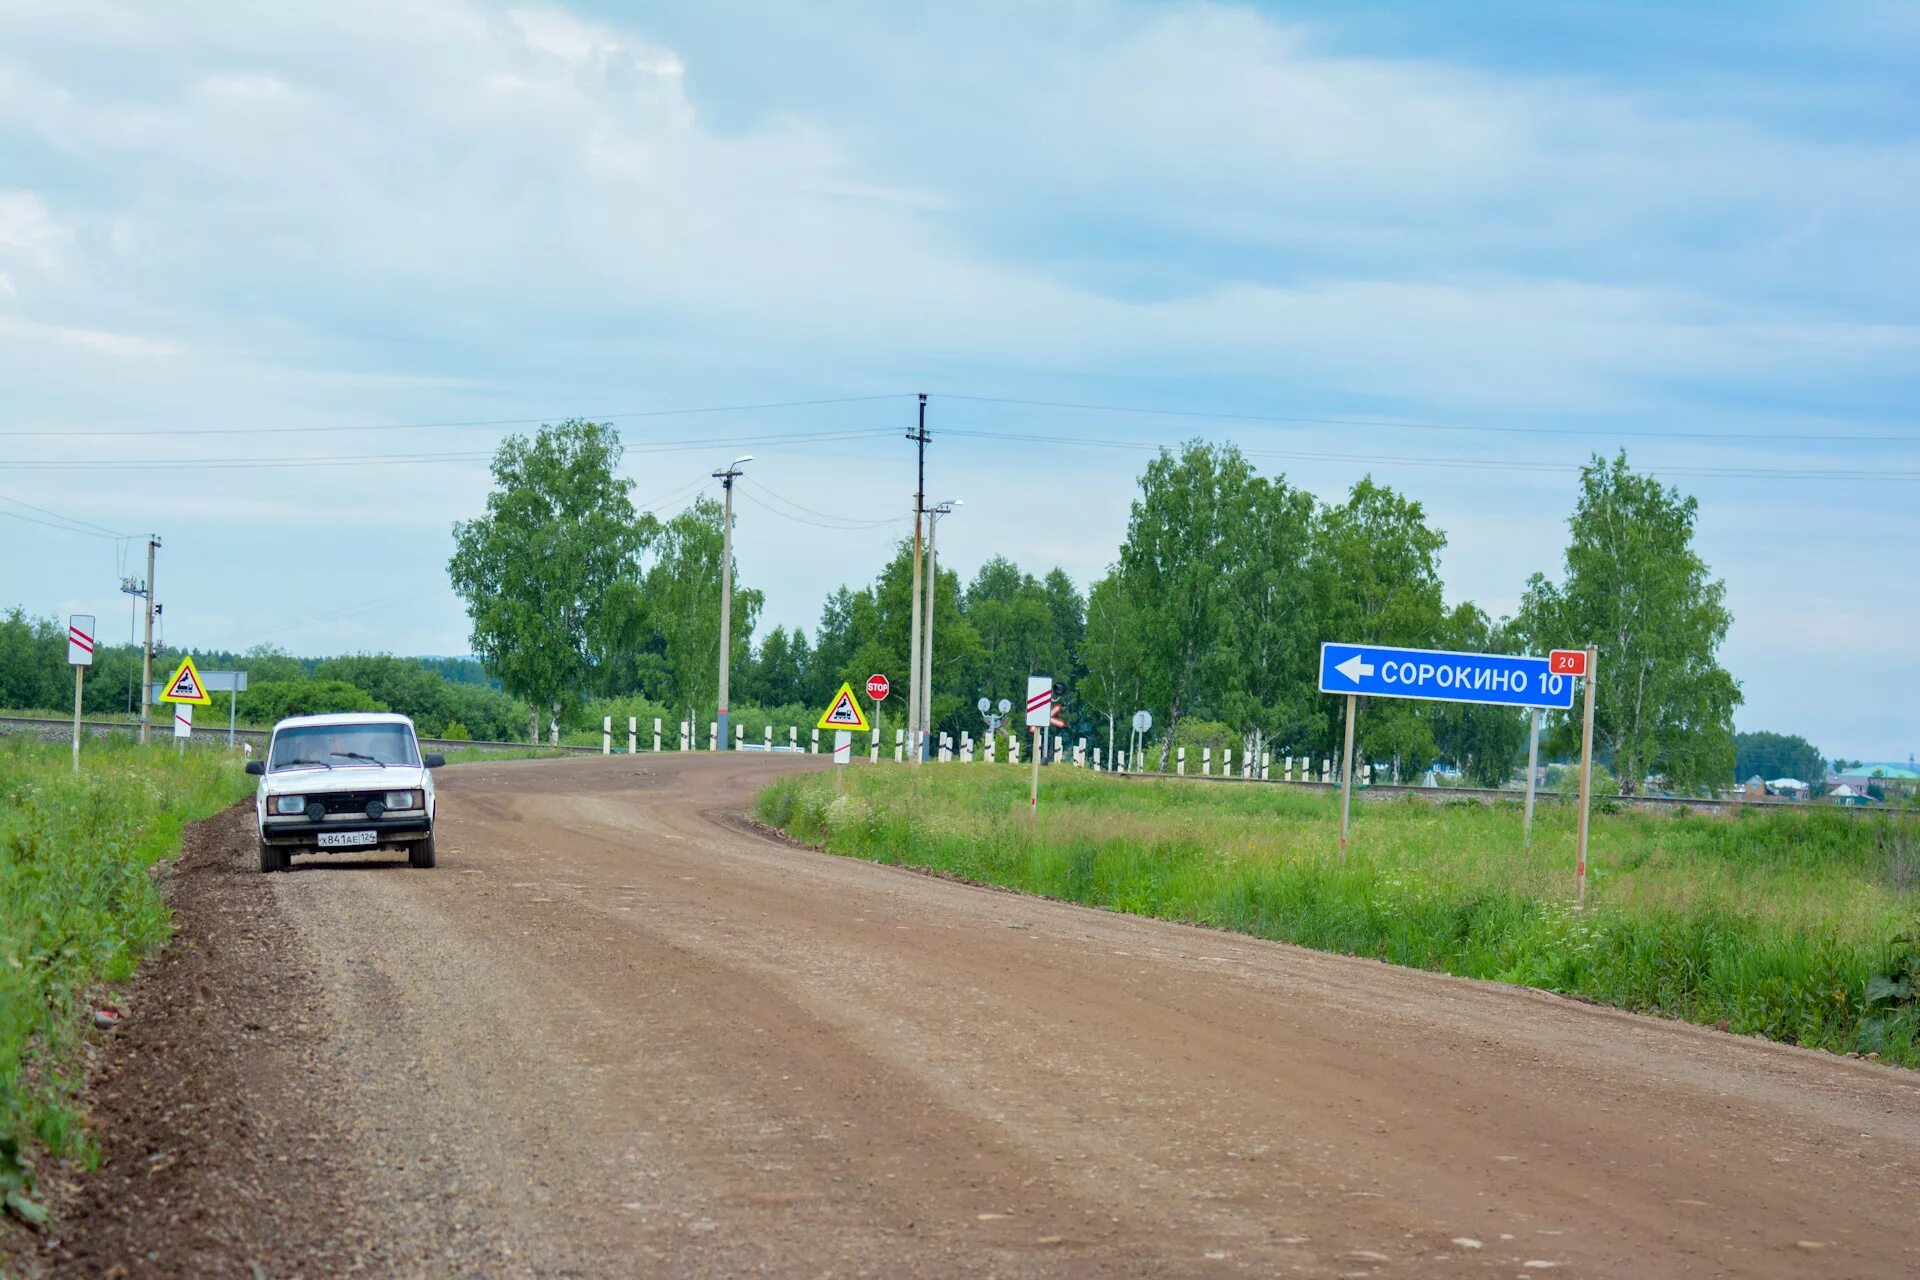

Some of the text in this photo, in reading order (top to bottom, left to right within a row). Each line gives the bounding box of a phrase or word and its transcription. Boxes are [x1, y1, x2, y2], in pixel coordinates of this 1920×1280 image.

[1558, 656, 1575, 669] 20
[1381, 660, 1563, 695] СОРОКИНО 10
[868, 682, 888, 692] STOP
